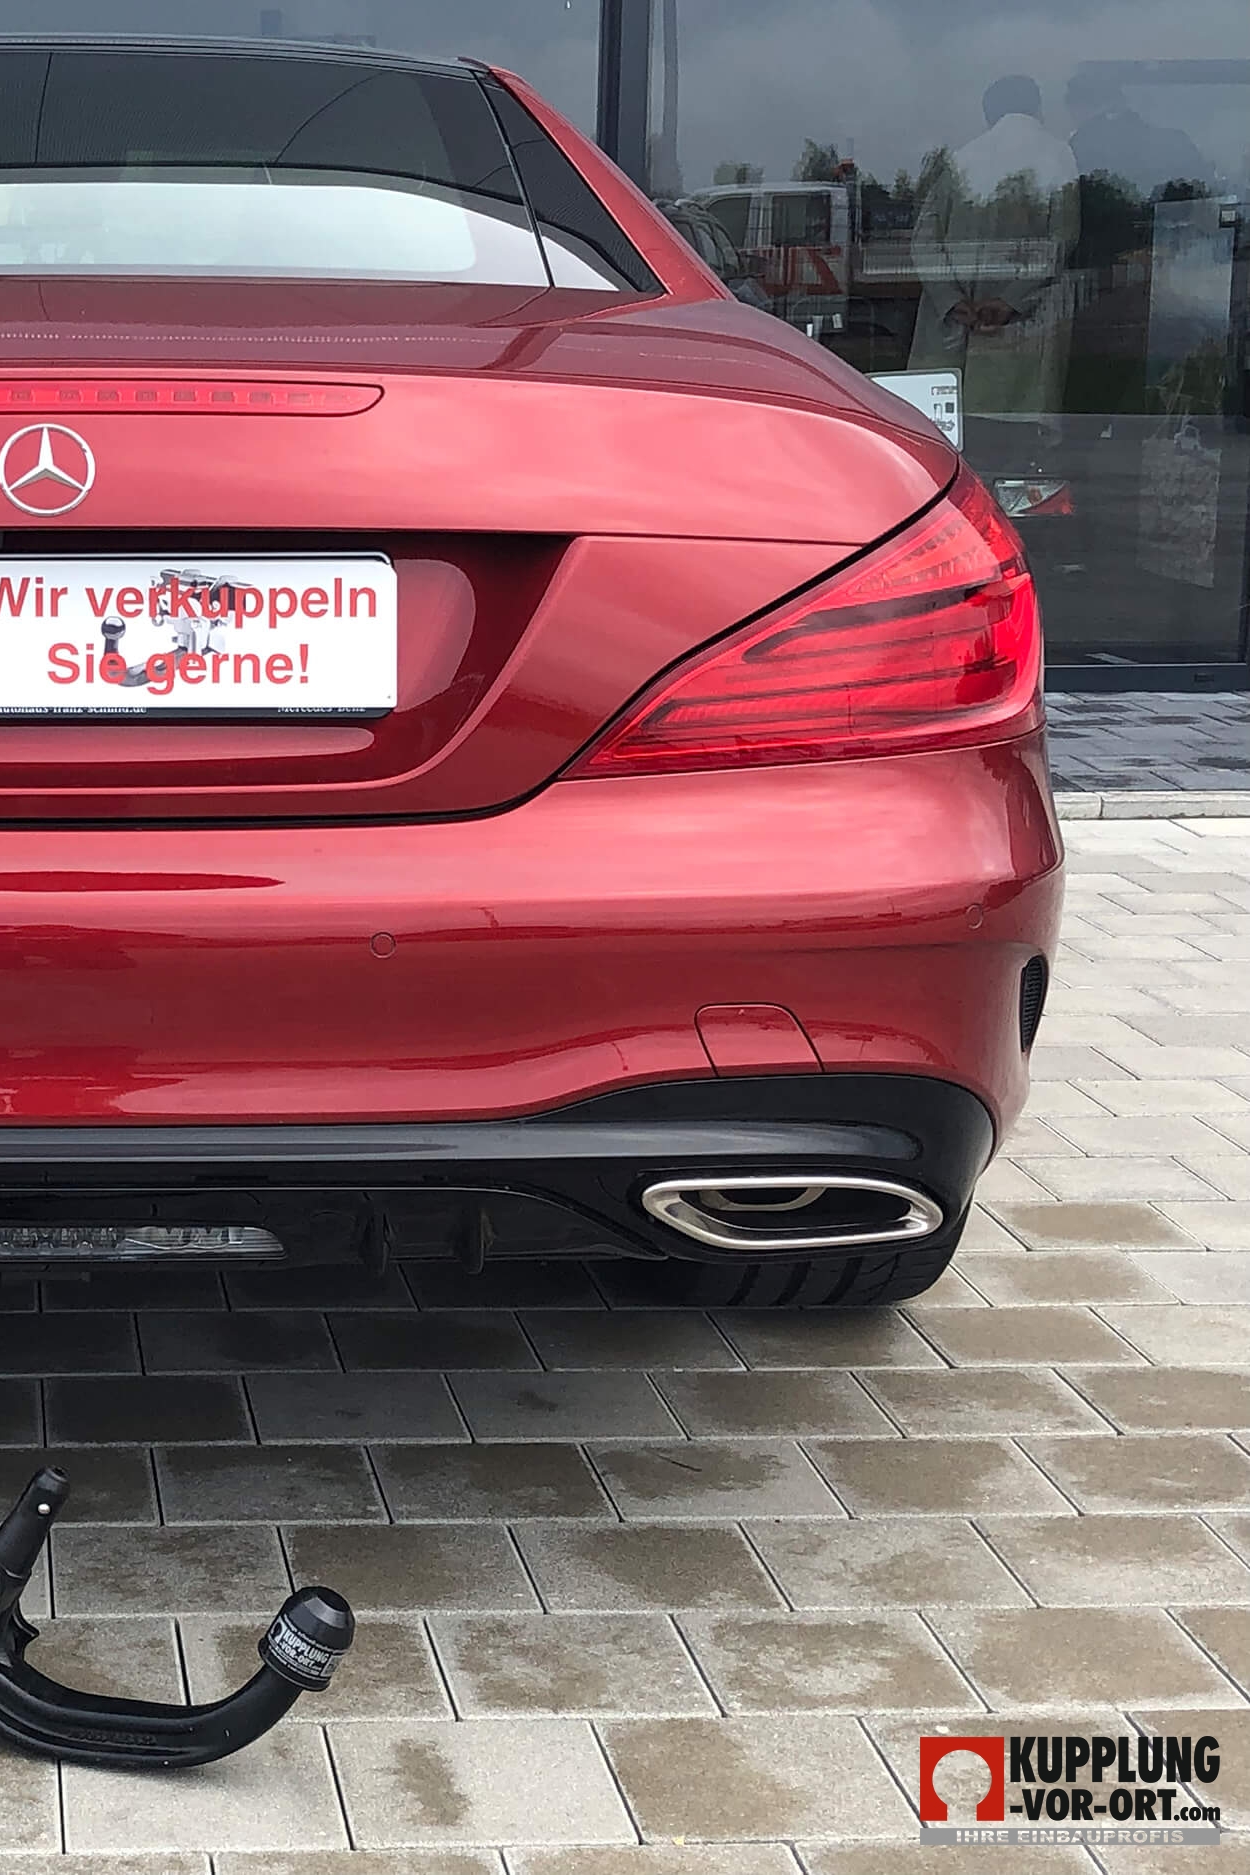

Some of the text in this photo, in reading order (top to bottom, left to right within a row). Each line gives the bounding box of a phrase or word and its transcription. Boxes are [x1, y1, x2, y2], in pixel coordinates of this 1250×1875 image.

[85, 577, 377, 628] verkuppeln
[47, 643, 309, 695] Sie gerne!
[283, 1629, 330, 1663] KUPPLUNG
